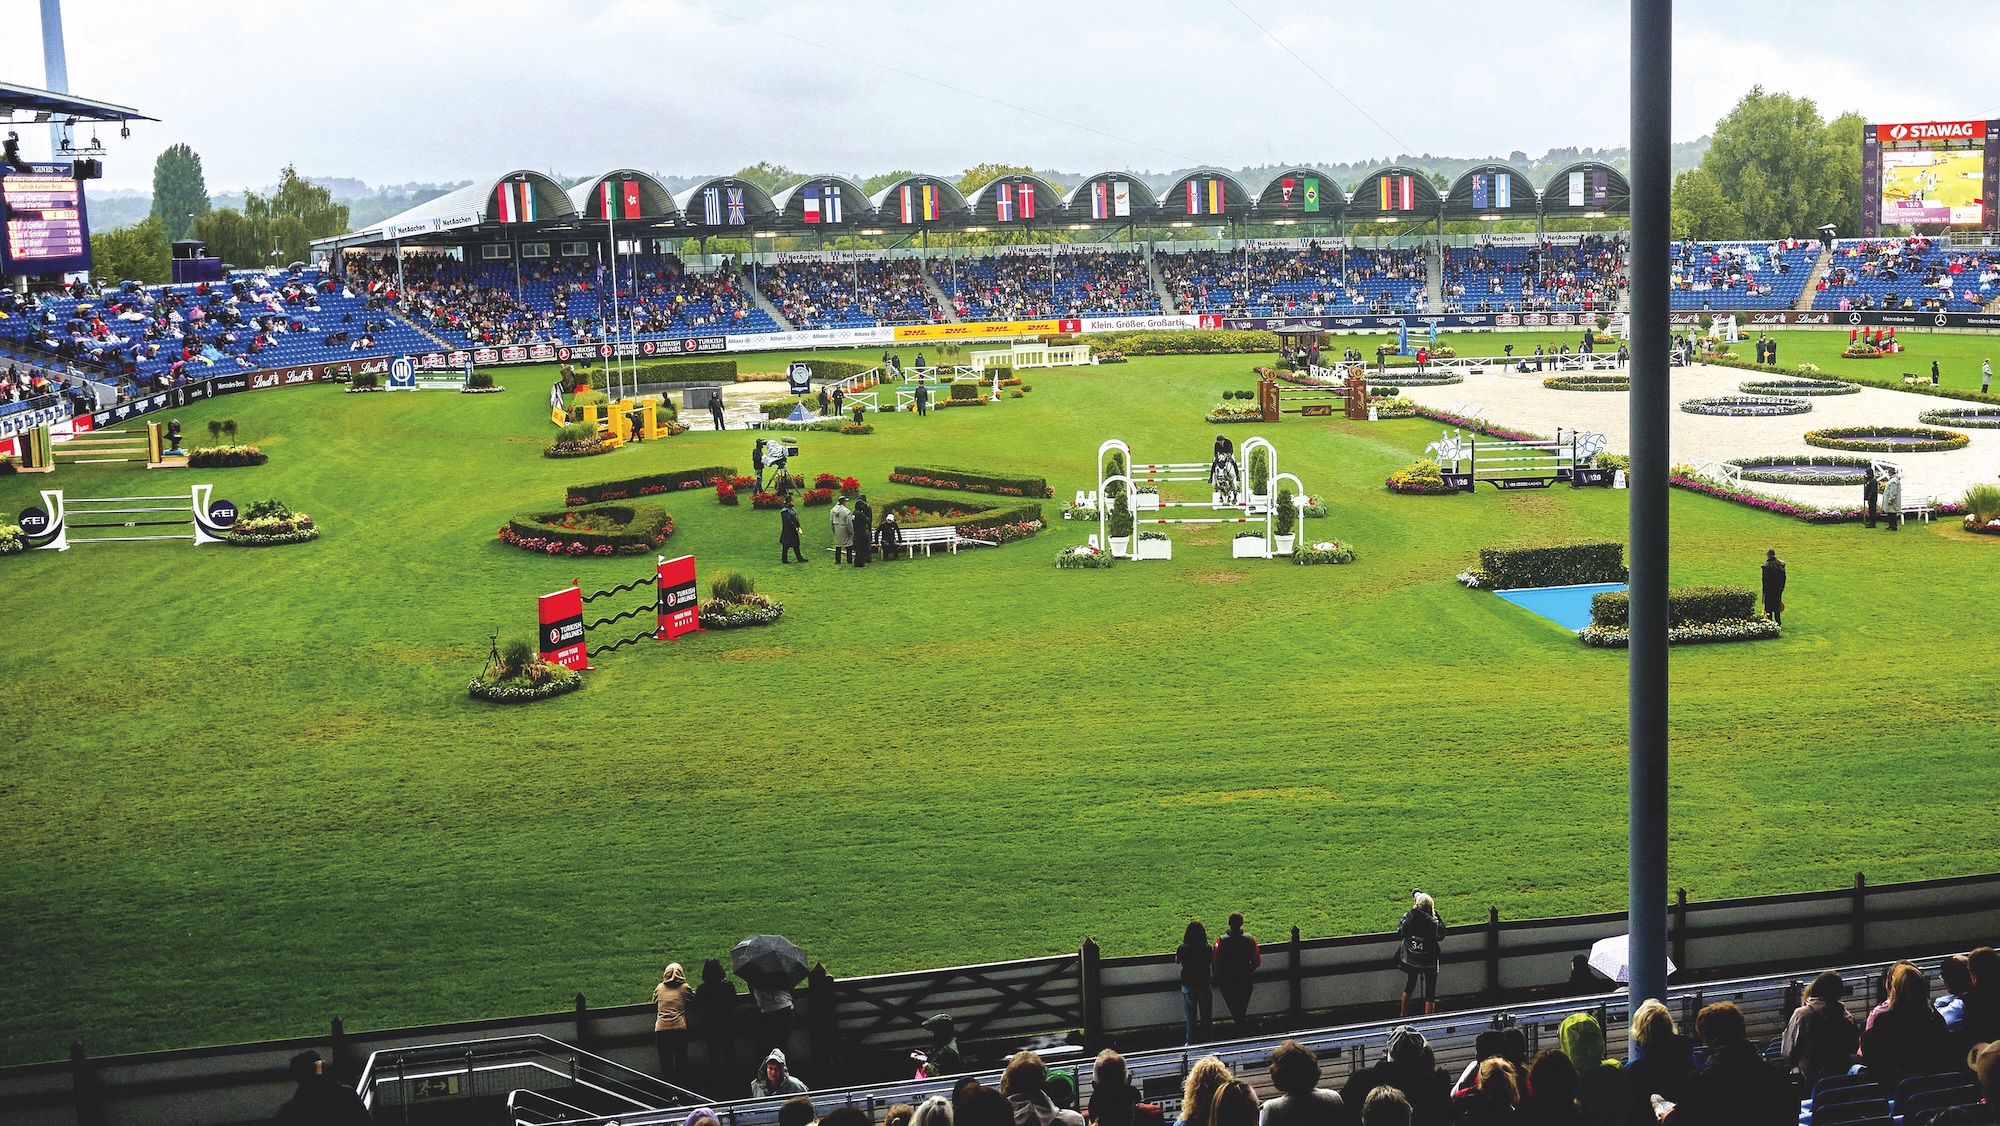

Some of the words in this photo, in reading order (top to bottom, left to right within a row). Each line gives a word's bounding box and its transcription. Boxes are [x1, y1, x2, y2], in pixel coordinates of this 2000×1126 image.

[1910, 123, 1973, 138] STAWAG
[1091, 321, 1114, 329] Klein.
[1116, 319, 1146, 329] Größer.
[1751, 313, 1781, 324] Lindt
[1795, 313, 1824, 324] Lindt
[1882, 315, 1915, 323] Mercedes-Benz
[656, 345, 682, 353] AIRLINES
[360, 361, 383, 374] Lindt
[252, 374, 274, 389] Lindt
[285, 370, 307, 384] Lindt
[210, 508, 235, 518] FEI
[21, 516, 45, 525] FEI
[676, 587, 696, 598] TURKISH
[677, 593, 697, 605] AIRLINES
[560, 621, 582, 633] TURKISH
[674, 617, 693, 628] WORLD
[561, 629, 583, 641] AIRLINES
[1411, 940, 1423, 950] 34
